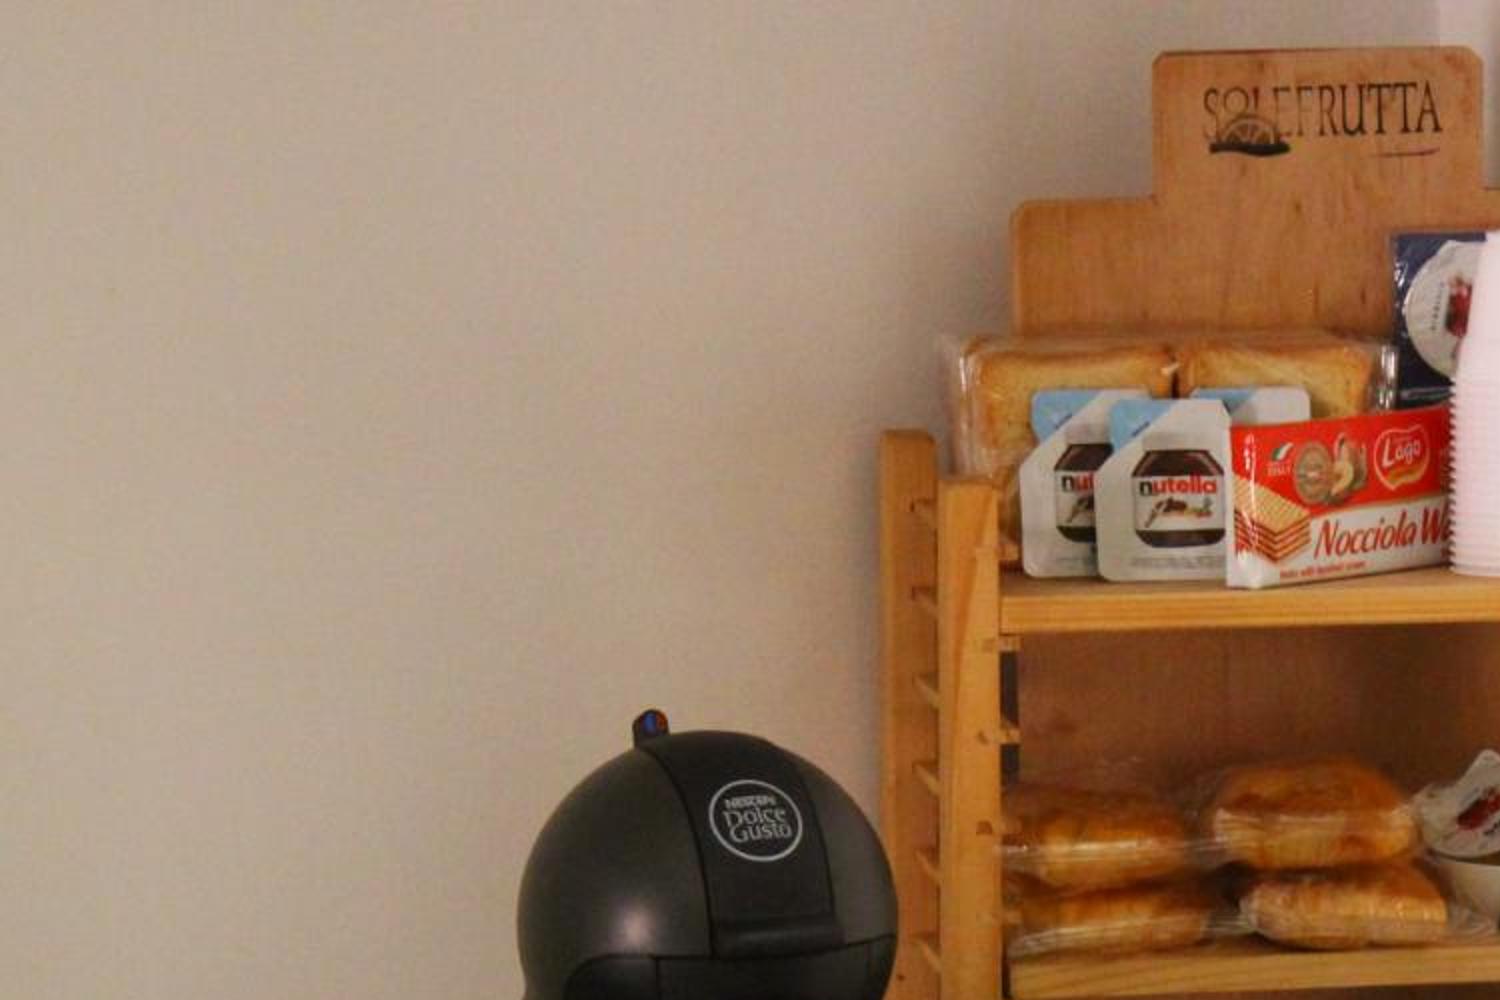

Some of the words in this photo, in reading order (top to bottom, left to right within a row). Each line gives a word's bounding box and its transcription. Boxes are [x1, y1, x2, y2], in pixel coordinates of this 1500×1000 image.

[1382, 437, 1422, 467] Lago
[1138, 470, 1218, 497] nutella
[1313, 509, 1418, 559] Nocciola
[722, 804, 787, 829] Dolce
[729, 823, 793, 844] Gusto
